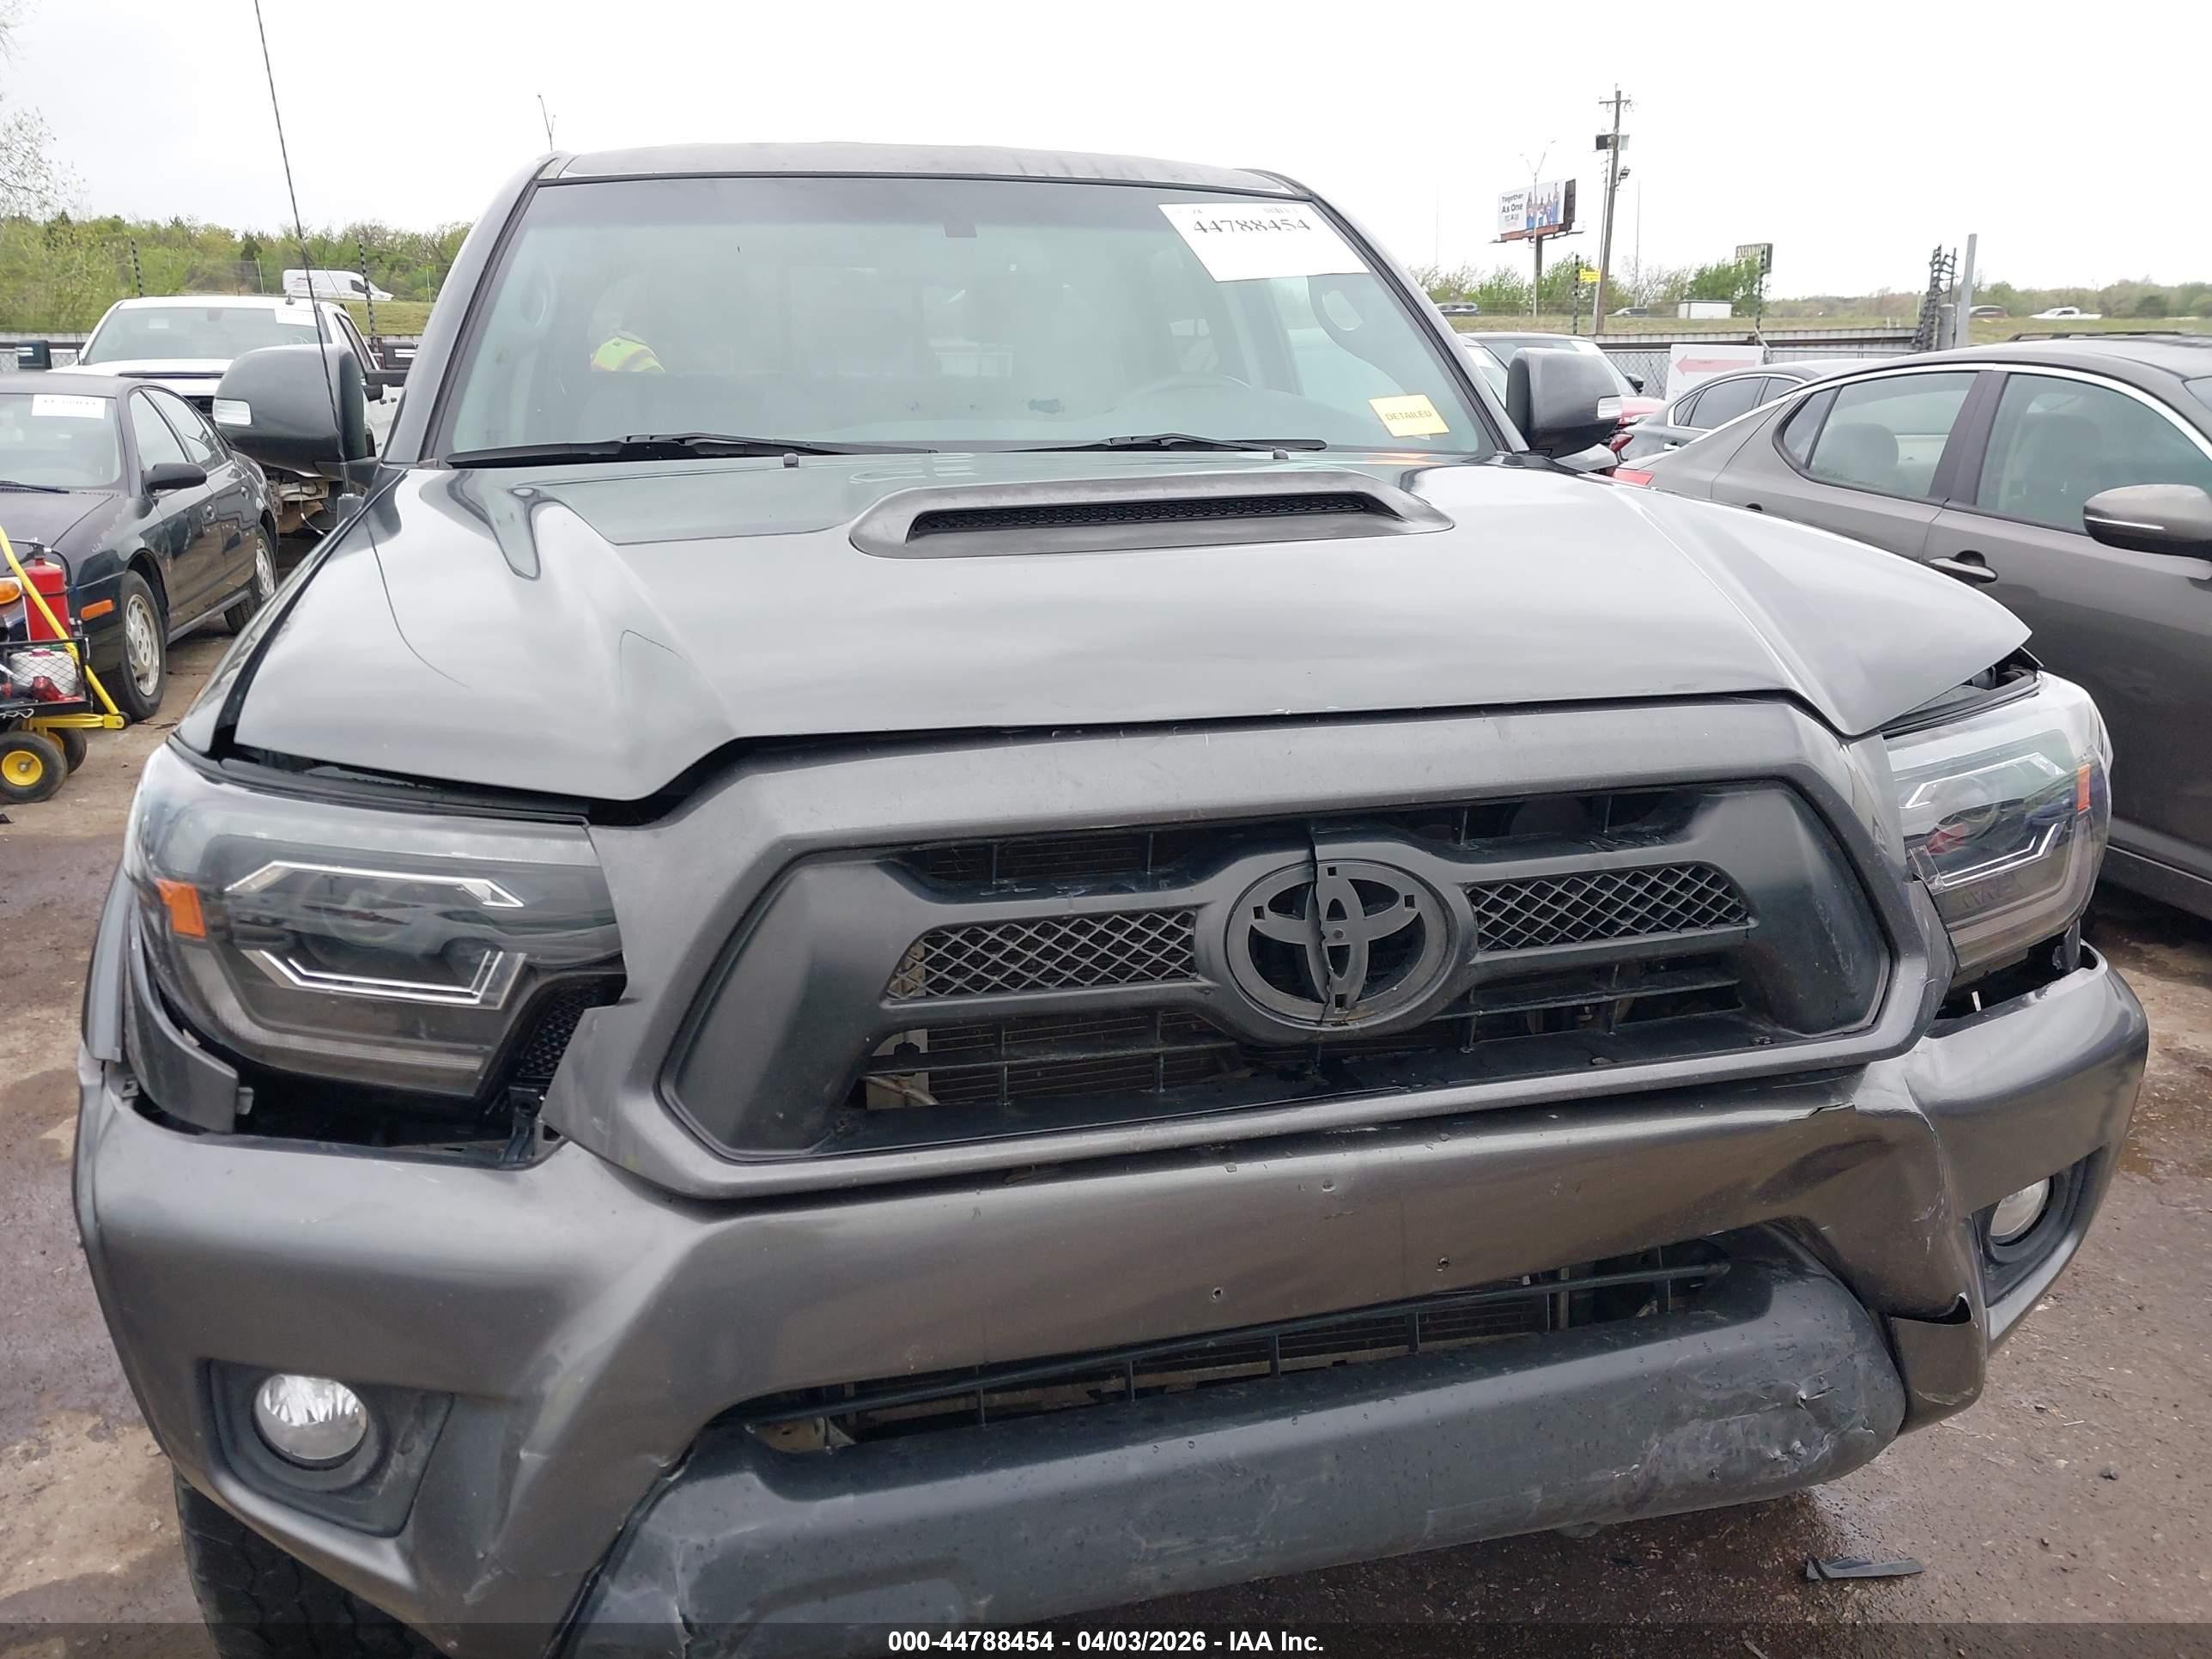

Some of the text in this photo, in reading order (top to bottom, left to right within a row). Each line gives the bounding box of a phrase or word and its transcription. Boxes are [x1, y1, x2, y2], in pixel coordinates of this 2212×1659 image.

[1501, 193, 1524, 204] Together
[1194, 219, 1311, 233] 44788454
[1384, 410, 1432, 421] DETAILED
